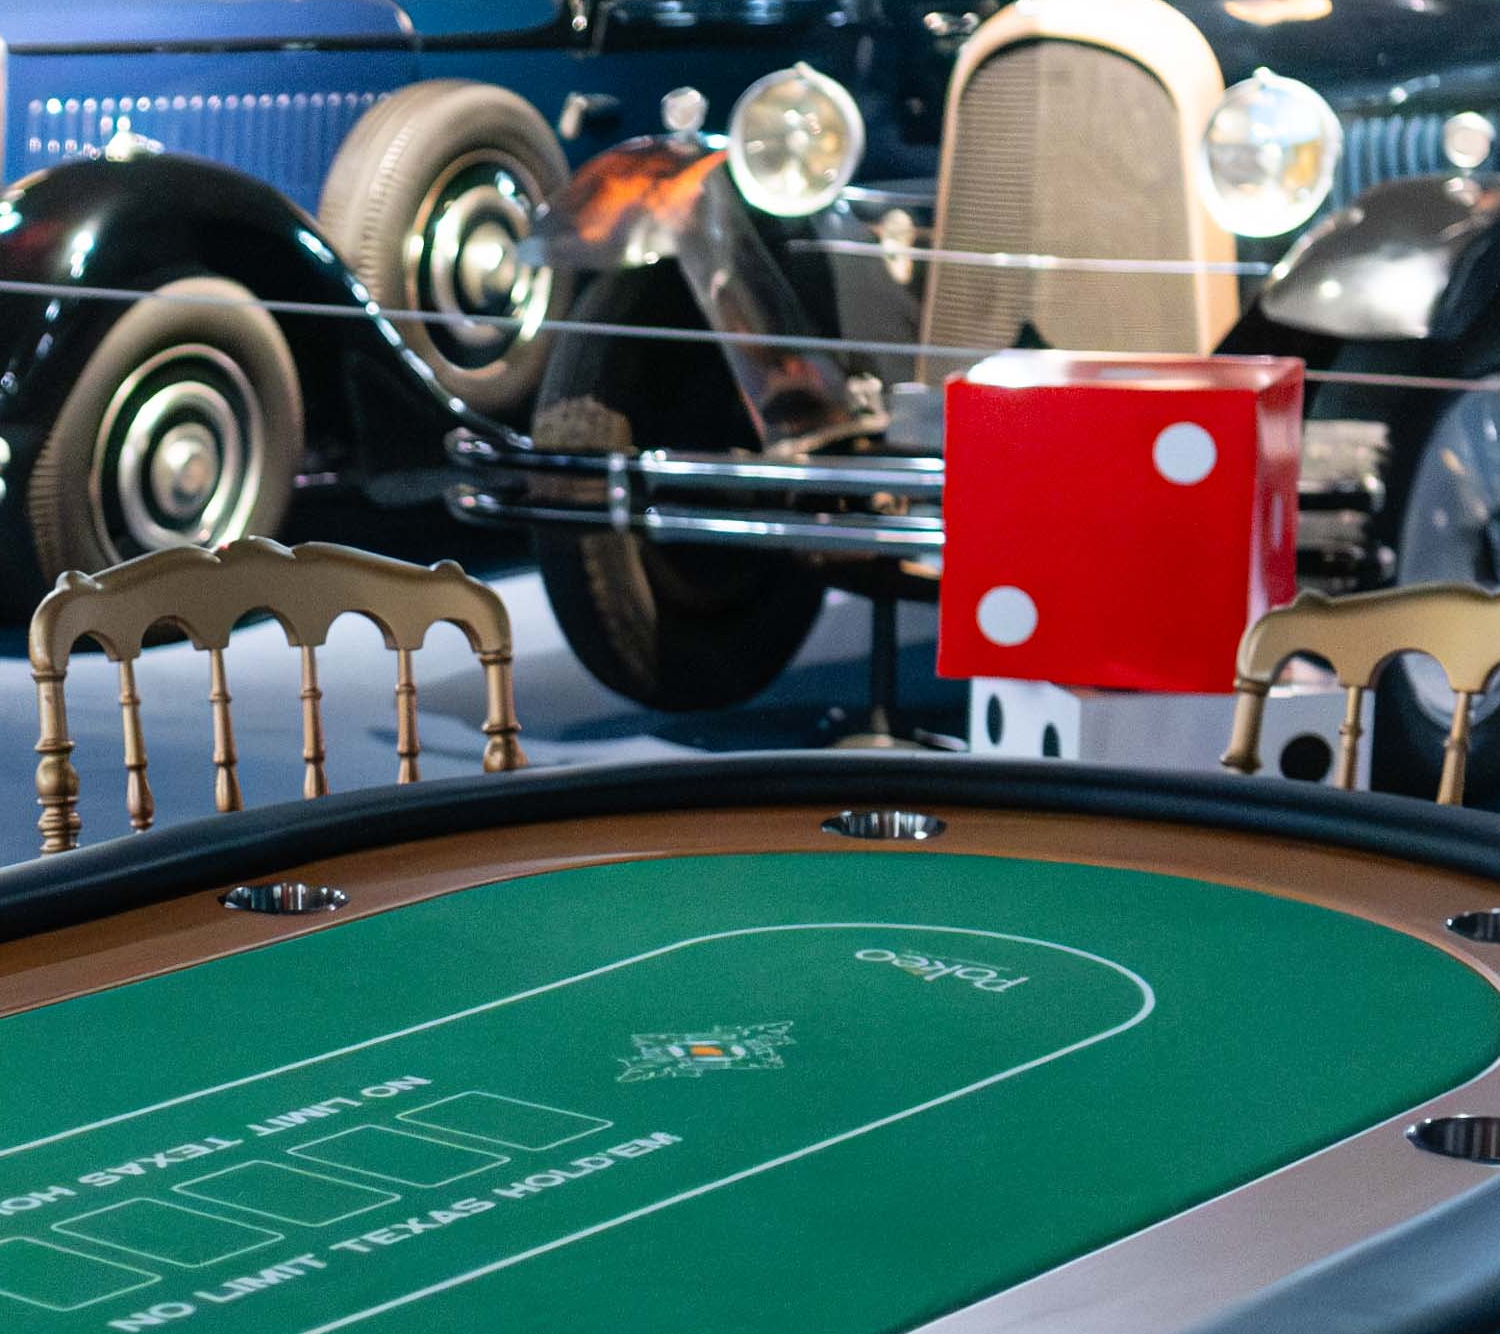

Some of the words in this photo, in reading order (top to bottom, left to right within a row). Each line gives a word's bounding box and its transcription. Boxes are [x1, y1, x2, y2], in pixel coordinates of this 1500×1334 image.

[855, 949, 1029, 992] Pokeo
[360, 1075, 432, 1098] NO
[246, 1097, 362, 1137] LIMIT
[77, 1137, 243, 1187] TEXAS
[108, 1301, 195, 1333] NO
[194, 1253, 327, 1303] LIMIT
[329, 1197, 497, 1253] TEXAS
[493, 1131, 683, 1198] HOLD'EM
